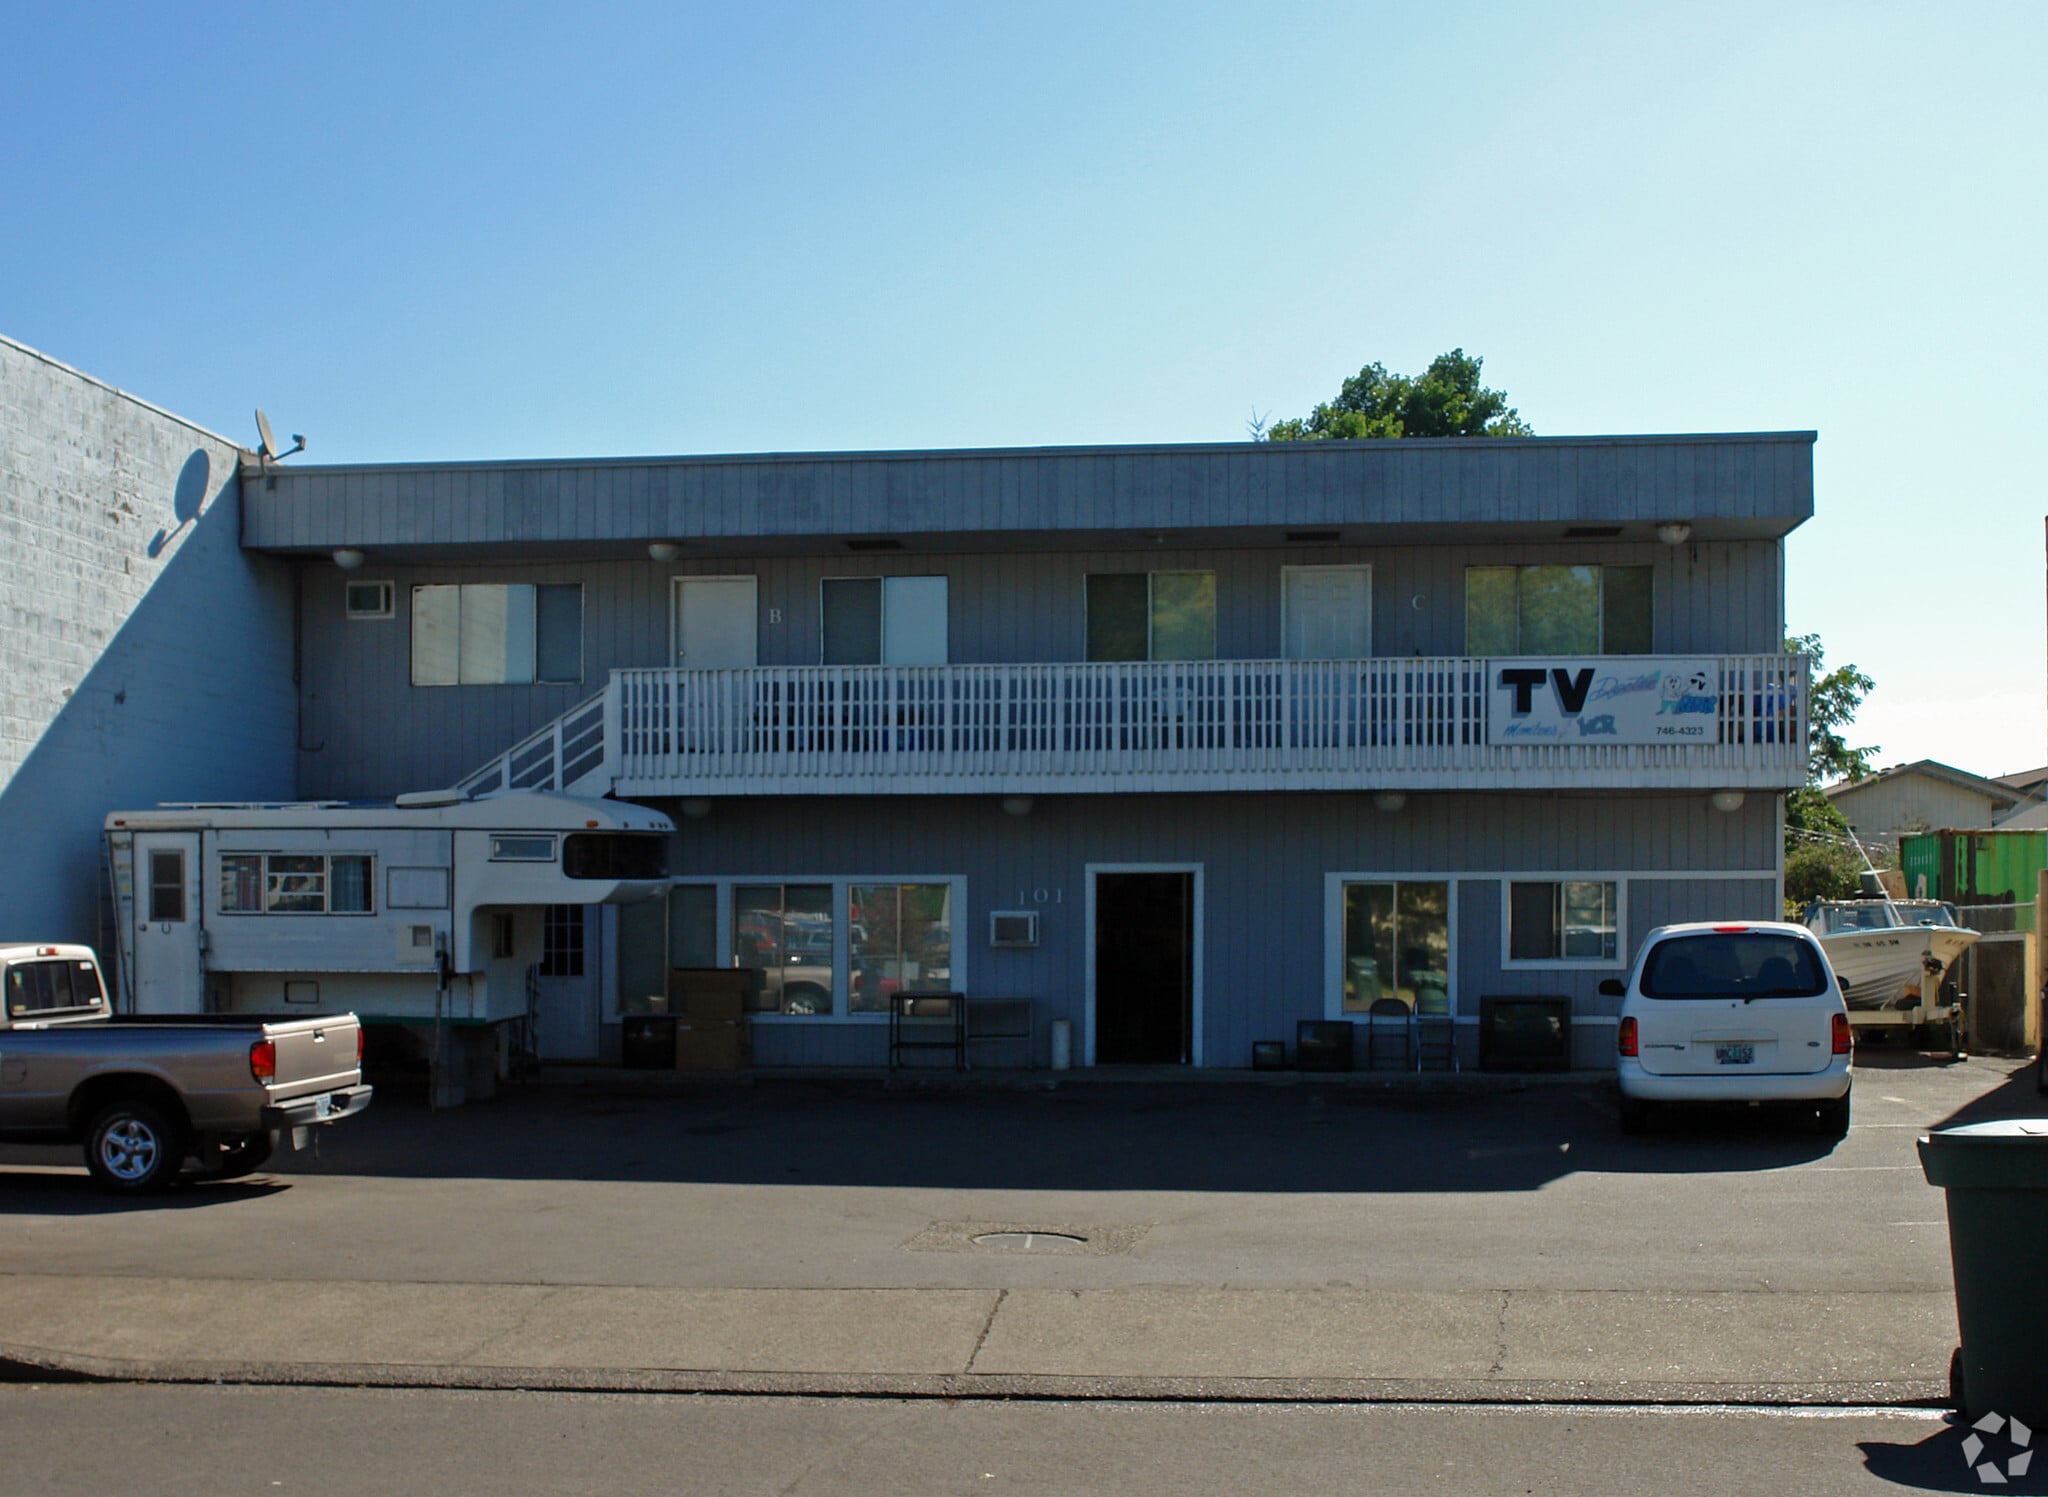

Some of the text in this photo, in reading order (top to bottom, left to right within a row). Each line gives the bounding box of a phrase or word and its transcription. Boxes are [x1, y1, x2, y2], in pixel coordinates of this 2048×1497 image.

[1412, 593, 1426, 611] C
[768, 608, 782, 624] B
[1498, 668, 1596, 717] TV
[1656, 726, 1704, 736] 746-4323
[1020, 887, 1062, 905] 101
